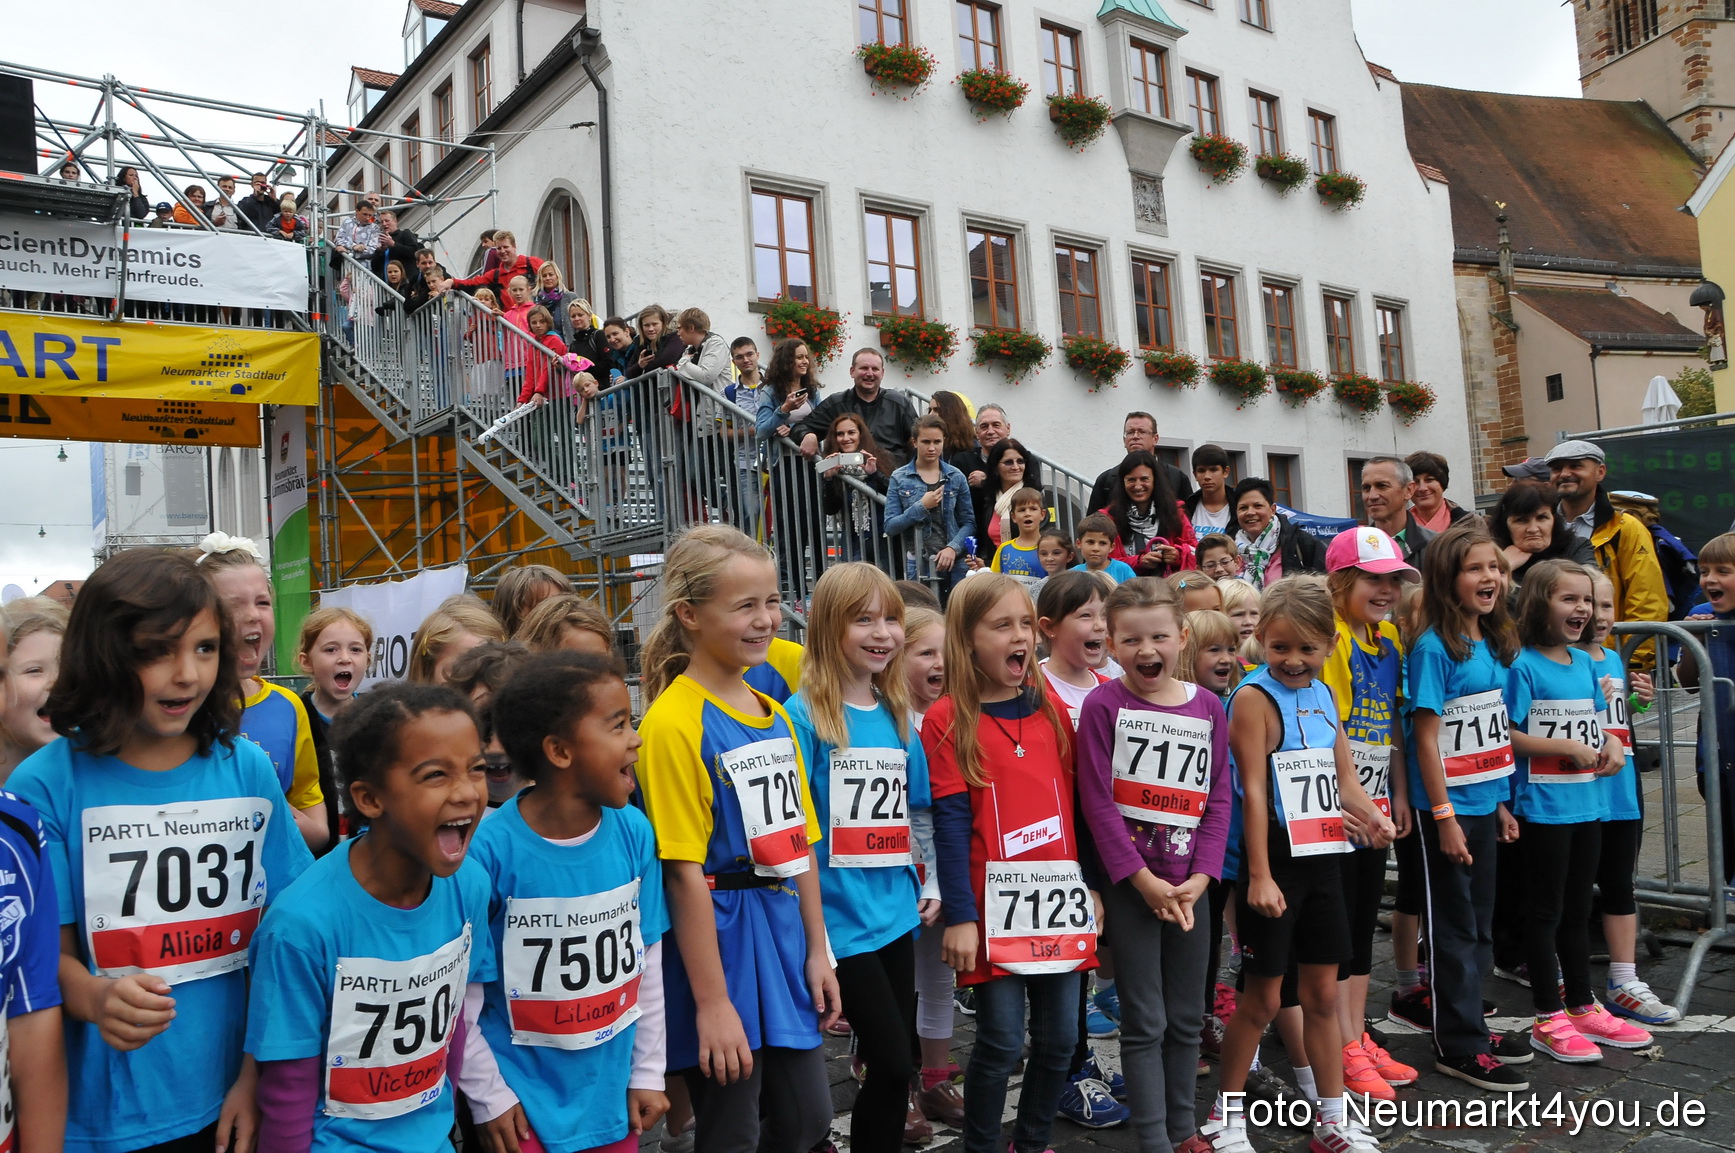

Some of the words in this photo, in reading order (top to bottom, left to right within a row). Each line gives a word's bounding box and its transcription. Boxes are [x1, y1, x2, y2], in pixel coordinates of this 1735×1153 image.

[54, 262, 100, 279] Mehr
[161, 366, 231, 379] Neumarkter
[234, 369, 287, 381] Stadtlauf
[121, 412, 186, 424] Neumarkter
[187, 414, 236, 427] Stadtlauf
[1530, 708, 1562, 717] PARTL
[1119, 719, 1158, 733] PARTL
[1161, 724, 1207, 741] Neumarkt
[1445, 709, 1509, 752] 7149
[729, 754, 771, 774] PARTL
[833, 760, 873, 771] PARTL
[1127, 735, 1208, 787] 7179
[1278, 759, 1315, 773] PARTL
[1141, 789, 1190, 811] Sophia
[89, 823, 159, 843] PARTL
[165, 816, 249, 837] Neumarkt
[1023, 826, 1048, 845] DEHN
[109, 840, 254, 917] 7031
[988, 873, 1028, 883] PARTL
[1030, 872, 1078, 883] Neumarkt
[507, 914, 562, 928] PARTL
[567, 901, 629, 927] Neumarkt
[999, 888, 1089, 931] 7123
[97, 916, 105, 929] 3
[160, 927, 223, 959] Alicia
[1030, 941, 1061, 958] Lisa
[522, 919, 636, 993] 7503
[340, 976, 402, 994] PARTL
[408, 950, 464, 990] Neumarkt
[509, 988, 520, 999] 3
[331, 1056, 343, 1067] 3
